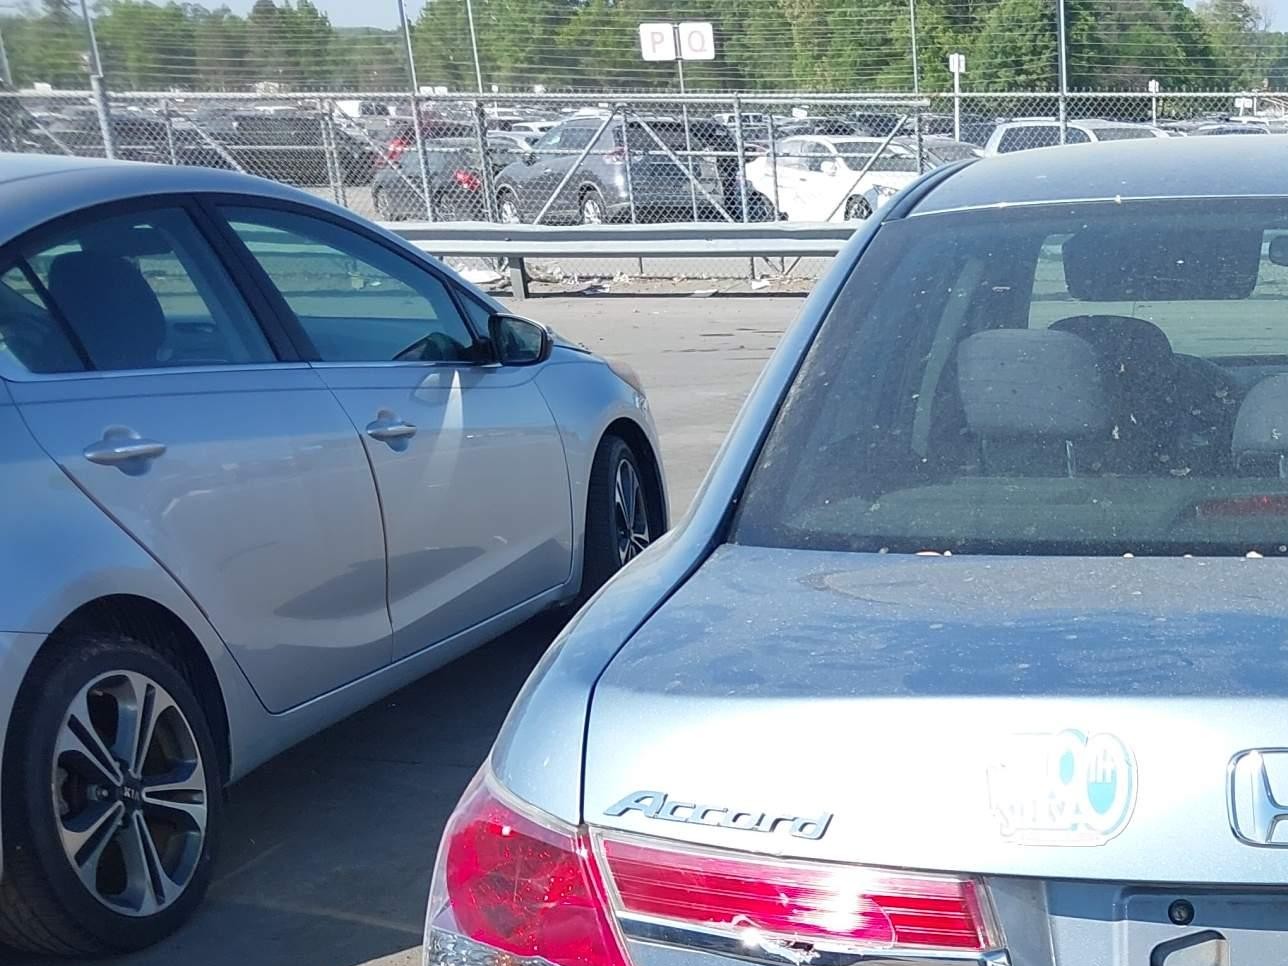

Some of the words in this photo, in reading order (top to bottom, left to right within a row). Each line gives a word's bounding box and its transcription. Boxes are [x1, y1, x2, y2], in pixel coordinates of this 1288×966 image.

[650, 31, 665, 53] P
[687, 30, 708, 53] Q
[603, 789, 834, 841] Accord
